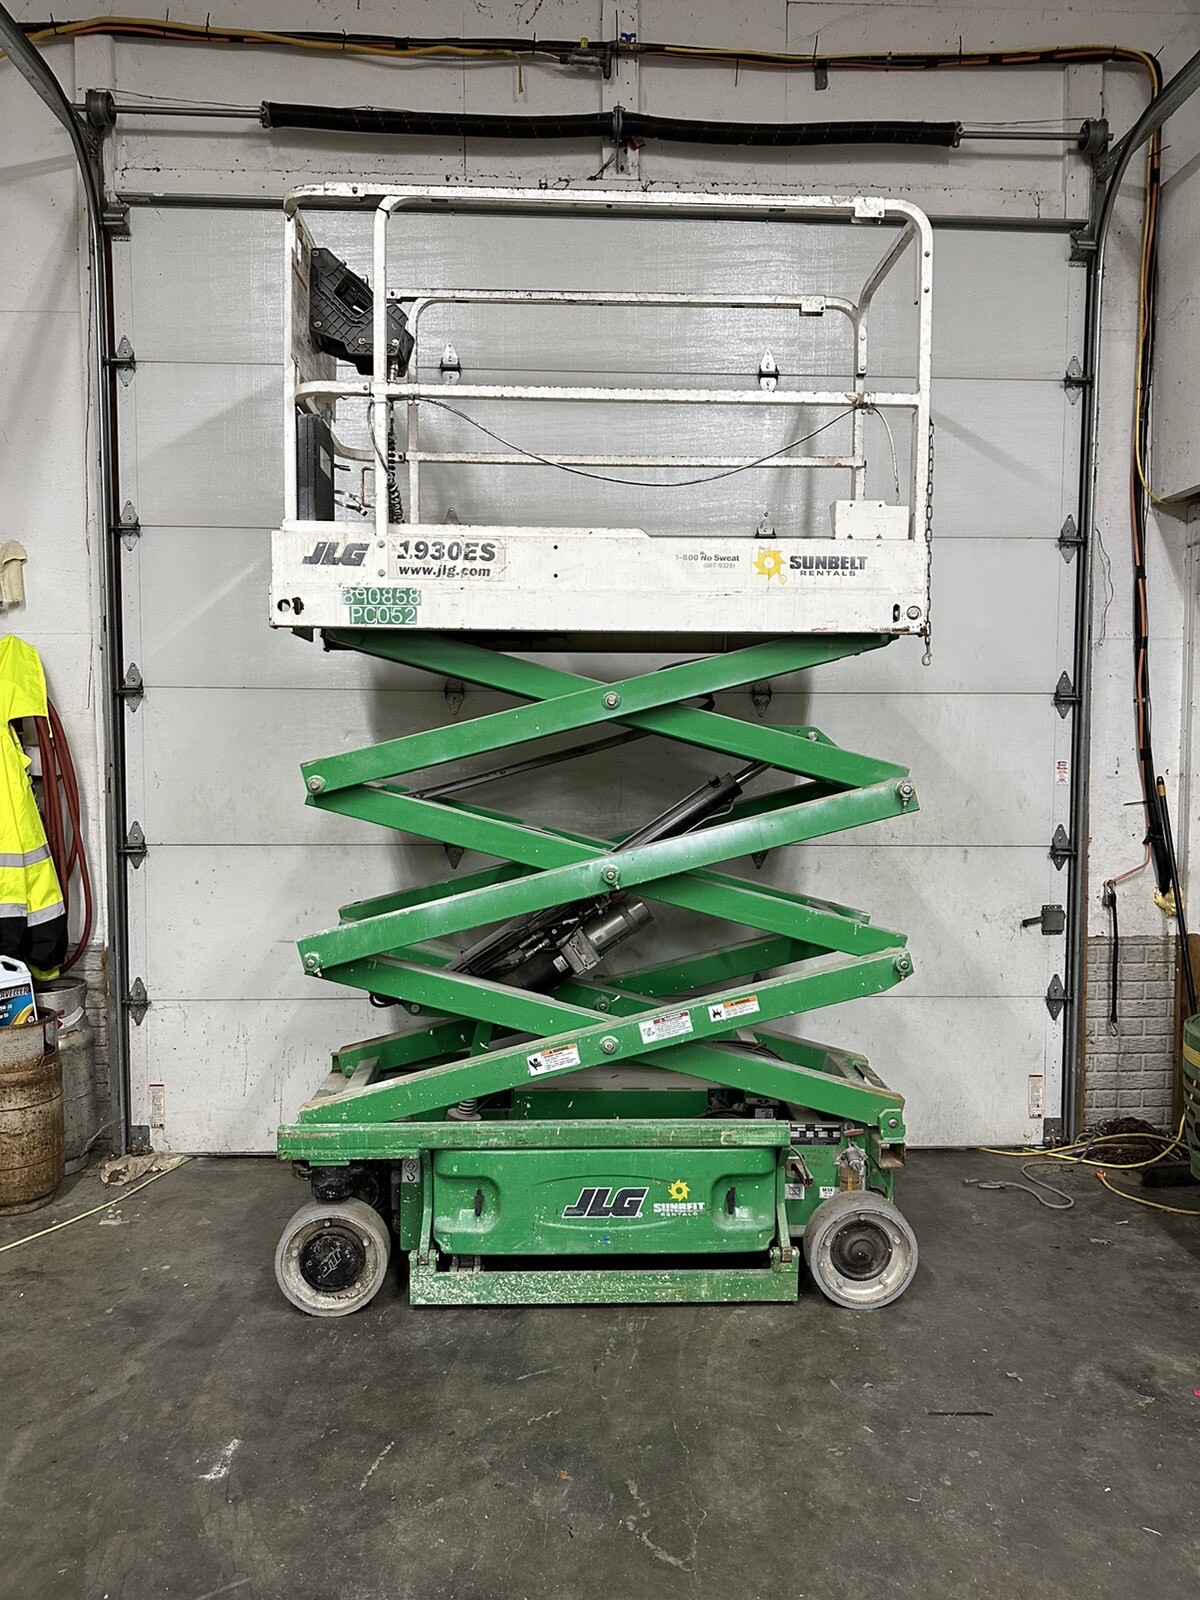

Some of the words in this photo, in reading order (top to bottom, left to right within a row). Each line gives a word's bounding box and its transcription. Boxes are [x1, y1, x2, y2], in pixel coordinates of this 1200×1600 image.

[301, 541, 369, 566] JLG
[397, 540, 496, 561] 1930ES
[789, 555, 868, 569] SUNBELT
[399, 565, 491, 578] www.jlg.com
[343, 587, 420, 605] 890858
[351, 607, 417, 624] PC052
[562, 1187, 650, 1219] JLG
